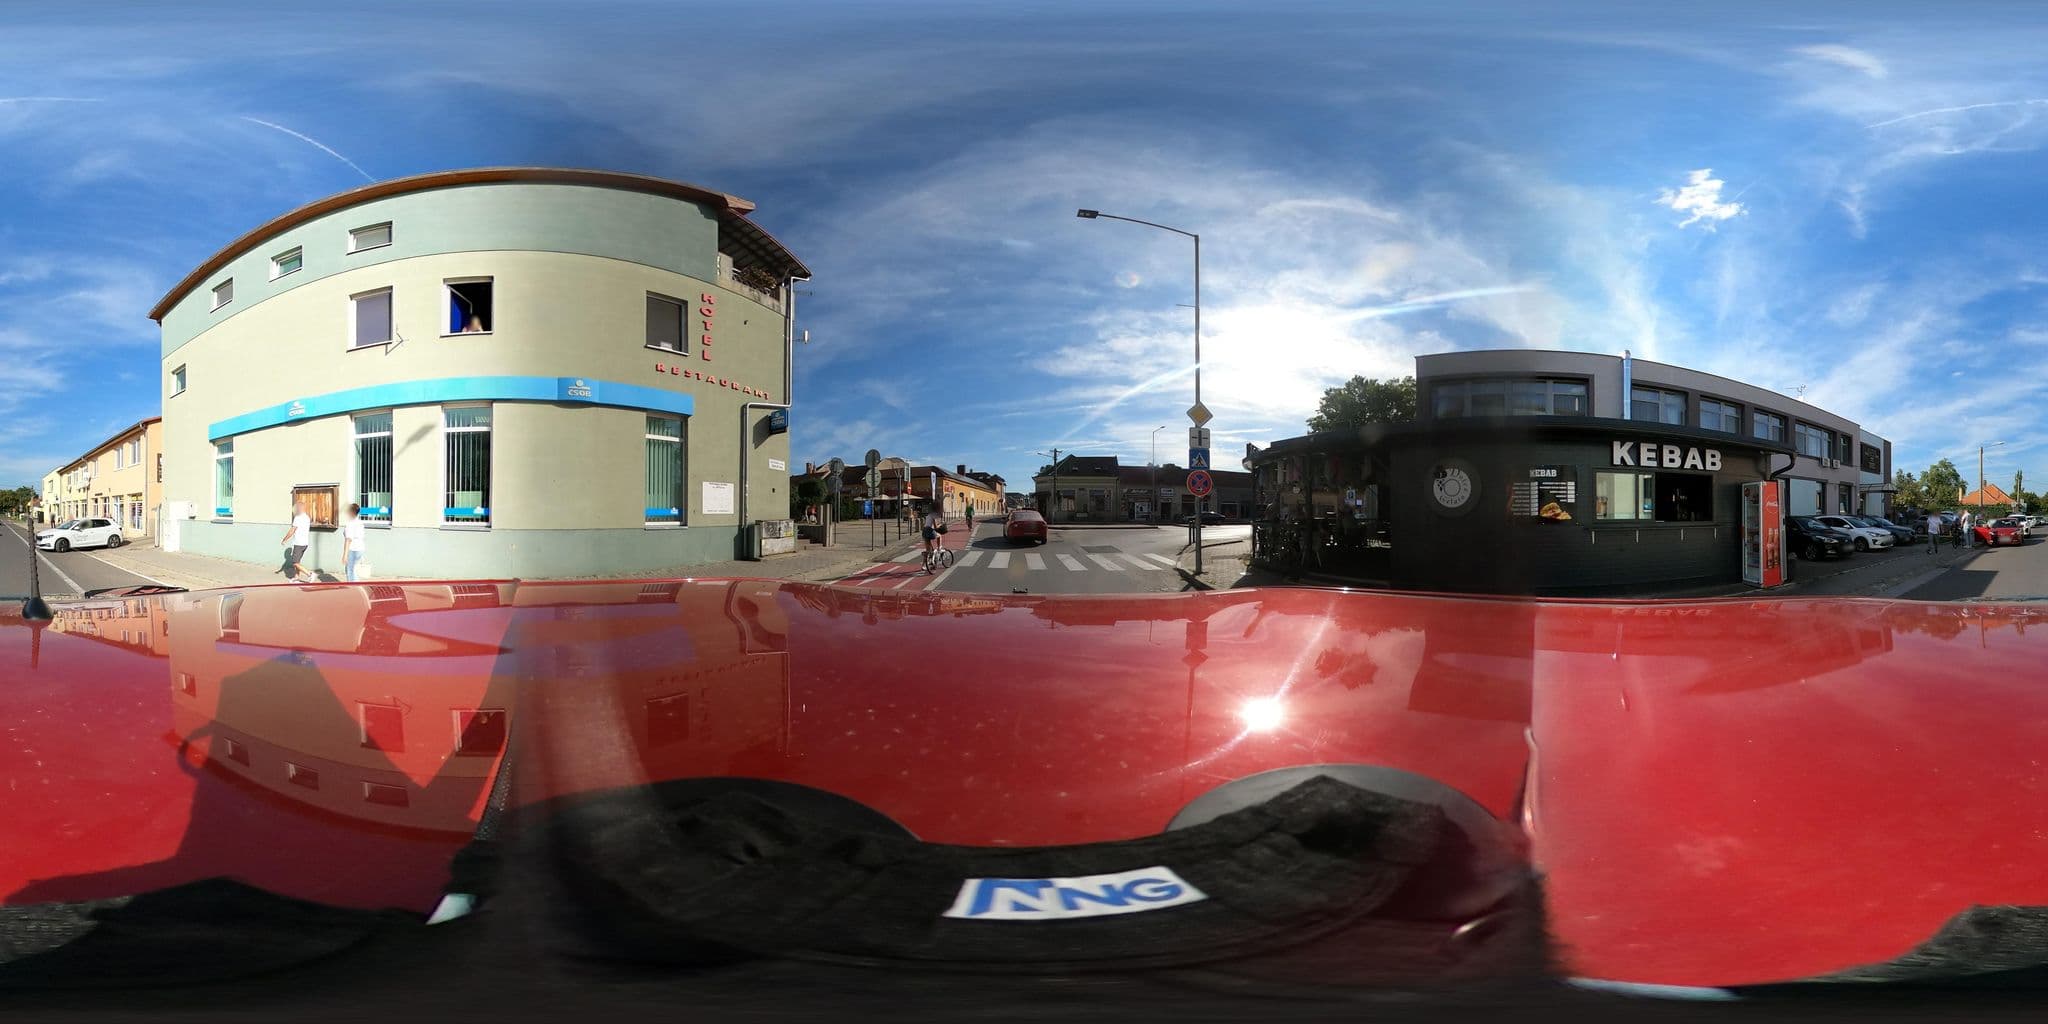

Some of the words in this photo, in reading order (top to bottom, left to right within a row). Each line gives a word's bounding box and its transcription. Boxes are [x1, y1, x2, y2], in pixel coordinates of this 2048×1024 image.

[700, 293, 716, 361] HOTEL
[655, 362, 769, 400] RESTAURANT
[1529, 469, 1557, 477] KEBAB
[1612, 441, 1722, 471] KEBAB
[967, 877, 1186, 916] NNG
